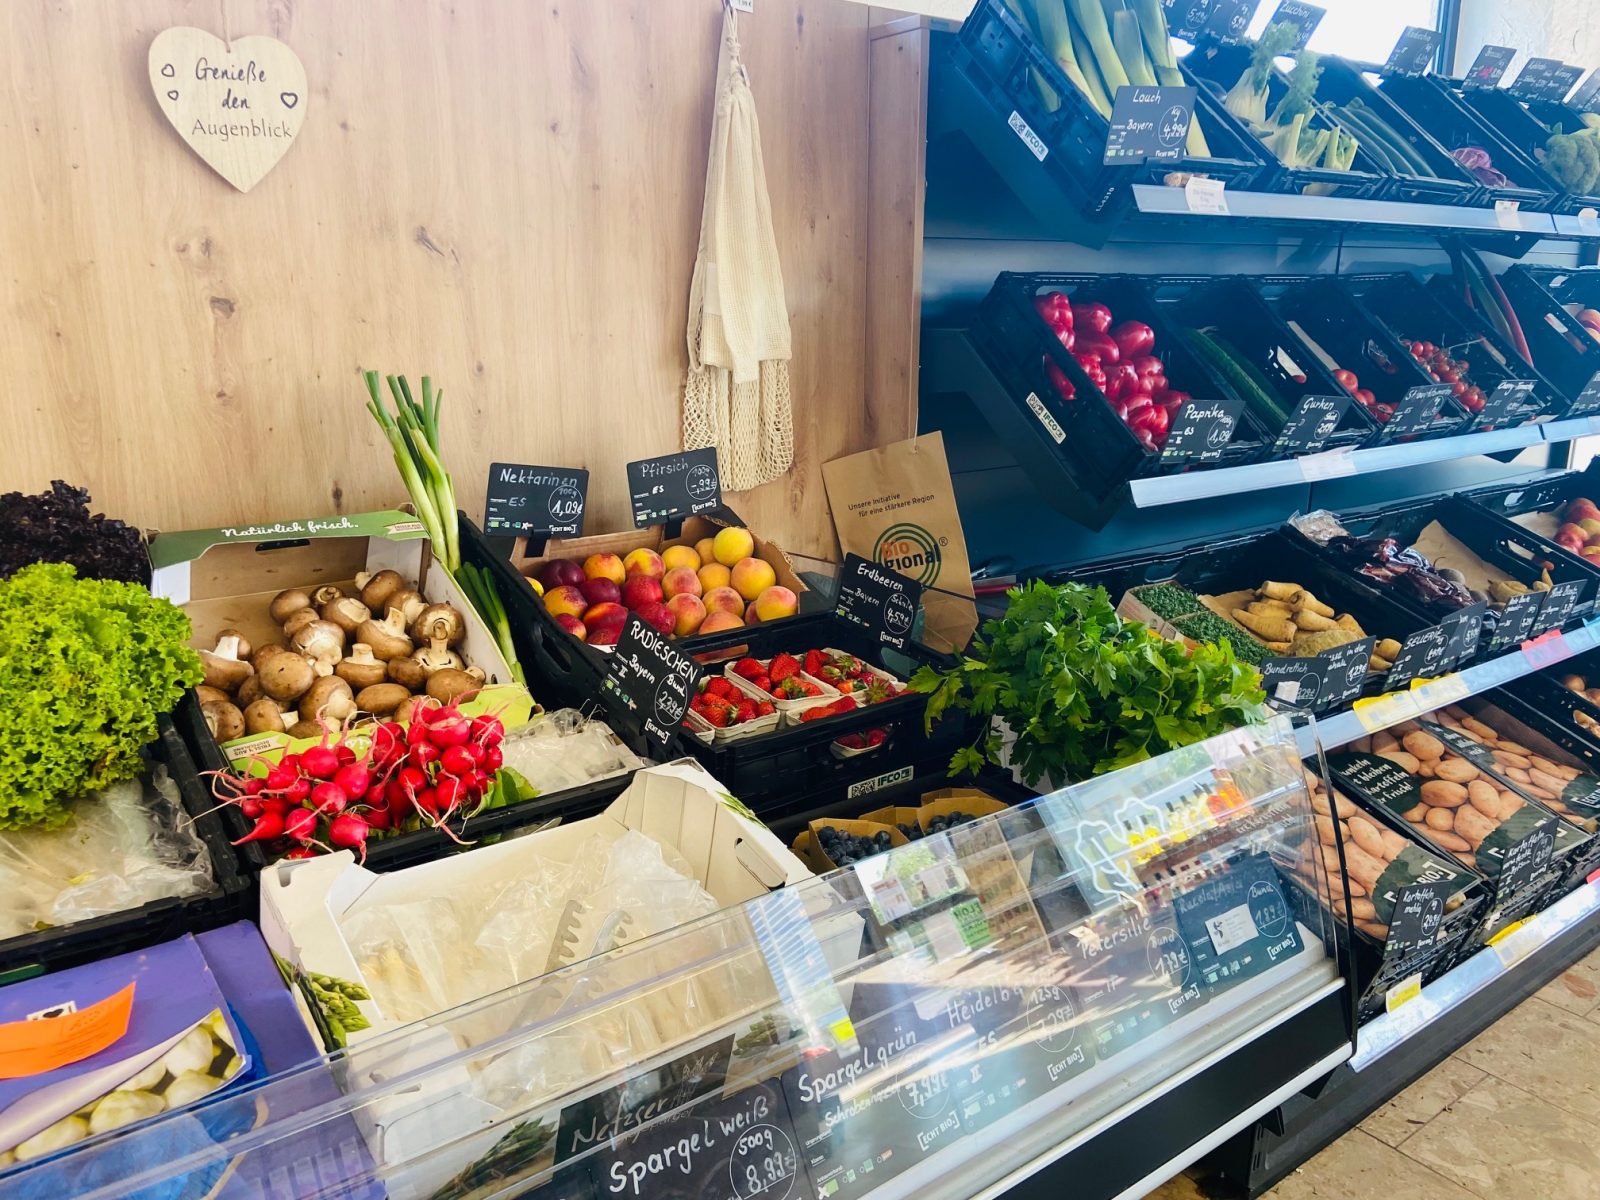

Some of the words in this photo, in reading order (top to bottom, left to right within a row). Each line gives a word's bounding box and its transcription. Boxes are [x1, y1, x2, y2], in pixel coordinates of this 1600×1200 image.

[195, 57, 266, 85] Genieße
[222, 88, 250, 110] den
[1132, 88, 1161, 104] Lauch
[192, 118, 292, 142] Augenblick
[1126, 119, 1154, 134] Bayern
[1025, 129, 1039, 147] IFCO
[1043, 412, 1058, 431] IFCO
[1184, 403, 1224, 423] Paprika
[641, 457, 688, 477] Pfirsich
[500, 468, 577, 488] Nektarinen
[652, 485, 665, 495] ES
[508, 497, 527, 507] ES
[552, 499, 583, 517] 1,09€
[848, 501, 871, 511] Unsere
[873, 493, 900, 505] Initiative
[869, 506, 883, 514] eine
[884, 500, 911, 512] stärkere
[912, 494, 935, 505] Region
[221, 522, 305, 537] Natürlich
[880, 539, 909, 558] Bio
[857, 563, 903, 592] Erdbeeren
[854, 587, 880, 606] Bayern
[1404, 626, 1443, 650] SELLERIE
[629, 654, 655, 684] Bayern
[667, 674, 685, 697] Bund
[877, 772, 901, 787] IFCO
[1357, 763, 1393, 782] bleiben
[1362, 771, 1410, 796] Kartoffeln
[1251, 884, 1274, 899] Bund
[1076, 914, 1152, 960] Petersilie
[799, 1047, 874, 1103] Spargel
[877, 1026, 917, 1069] grün
[609, 1121, 715, 1195] Spargel
[719, 1095, 769, 1137] weiß
[738, 1129, 773, 1156] 500g
